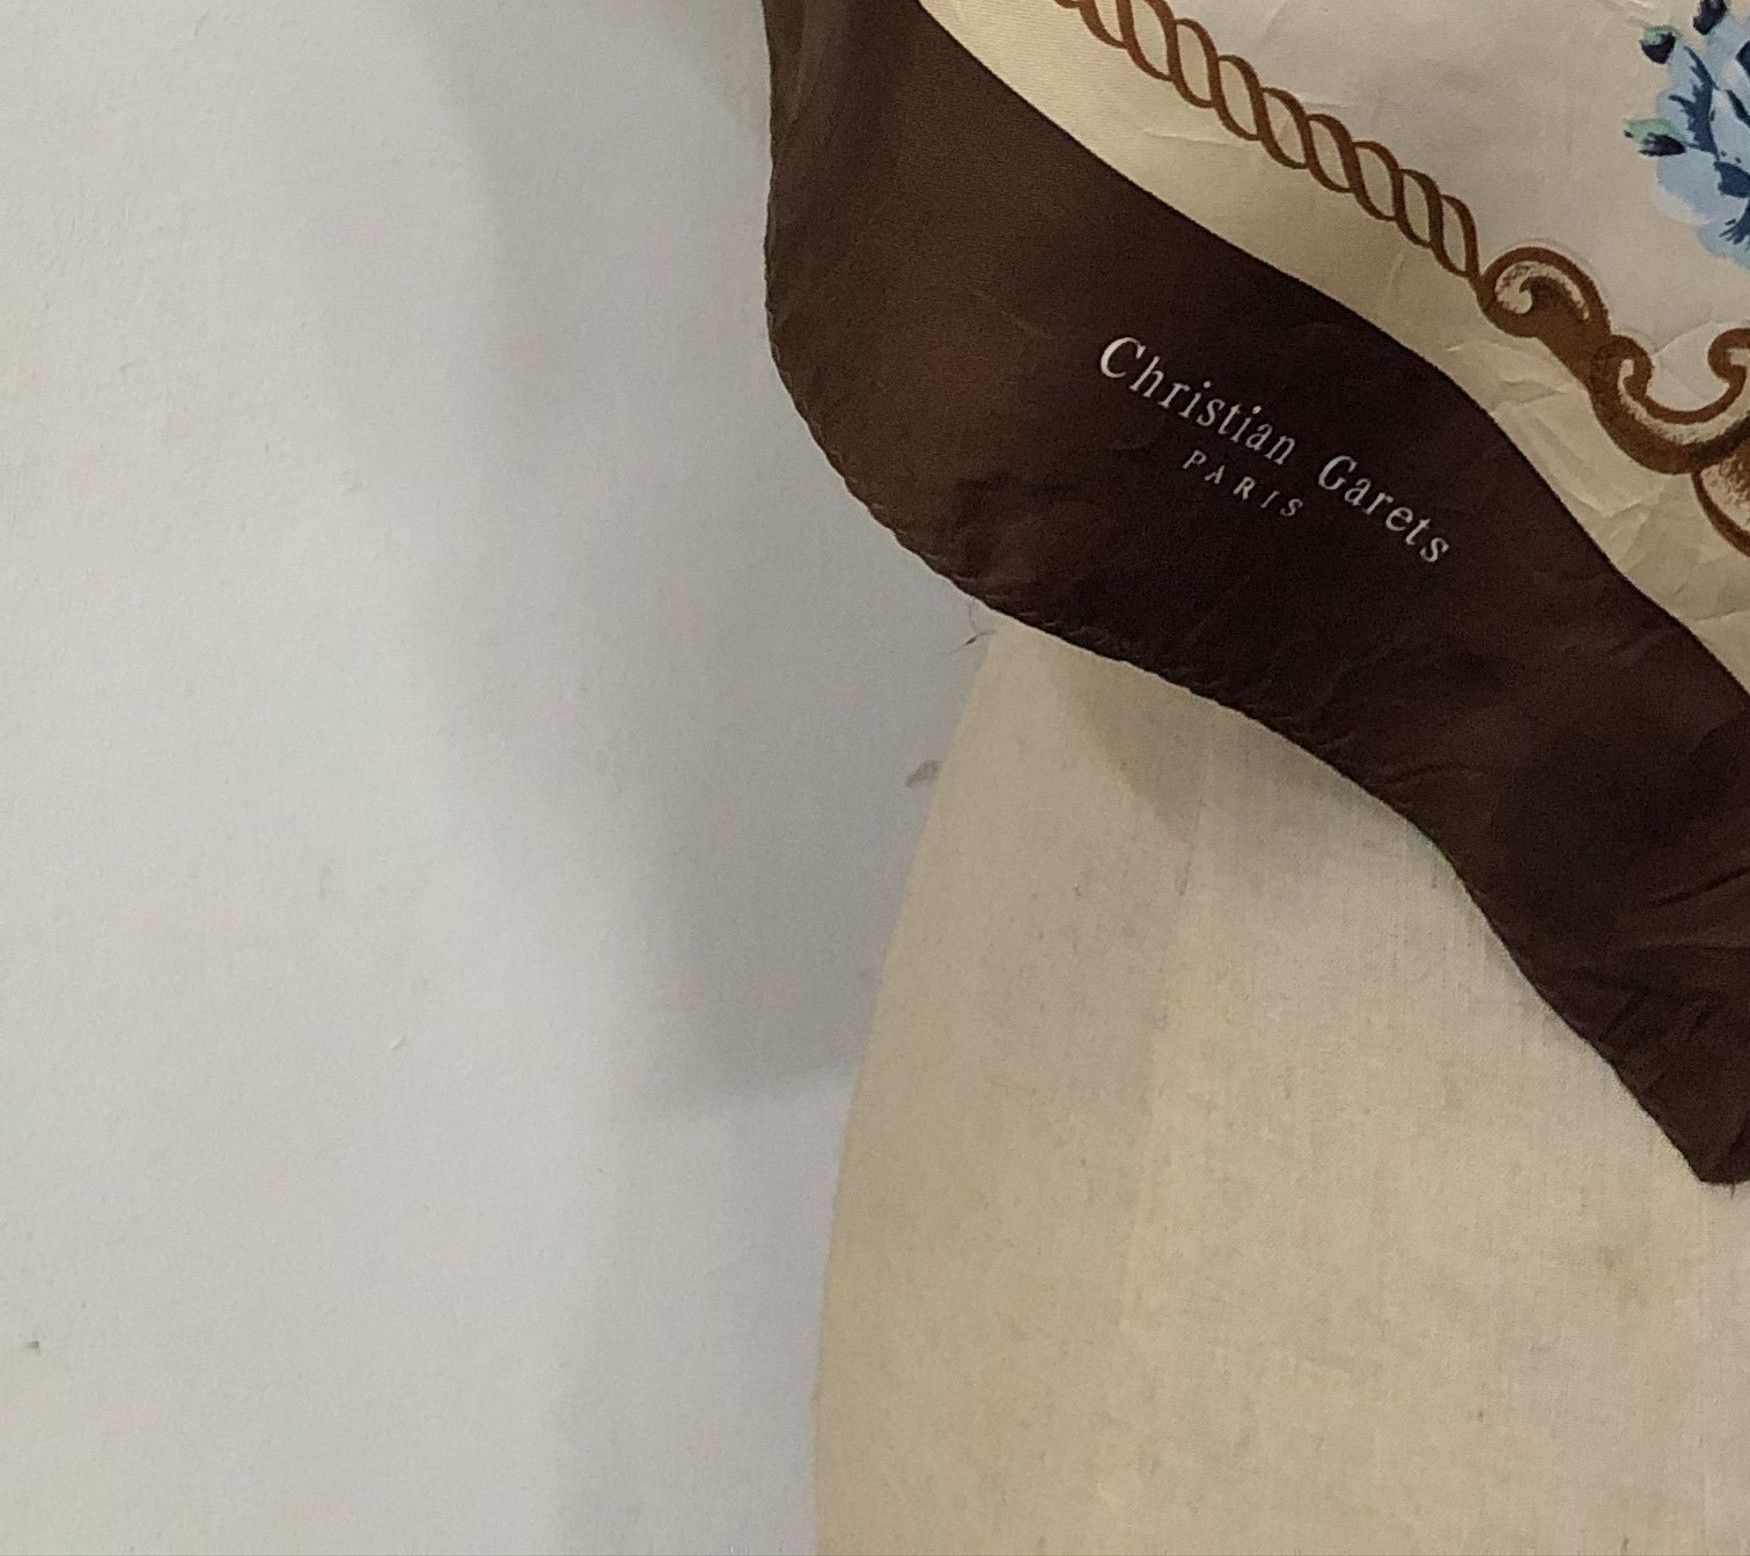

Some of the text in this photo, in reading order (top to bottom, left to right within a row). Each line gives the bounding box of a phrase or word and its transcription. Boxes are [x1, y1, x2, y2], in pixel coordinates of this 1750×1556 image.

[1100, 336, 1450, 564] Christian Garets
[1182, 449, 1304, 518] PARIS
